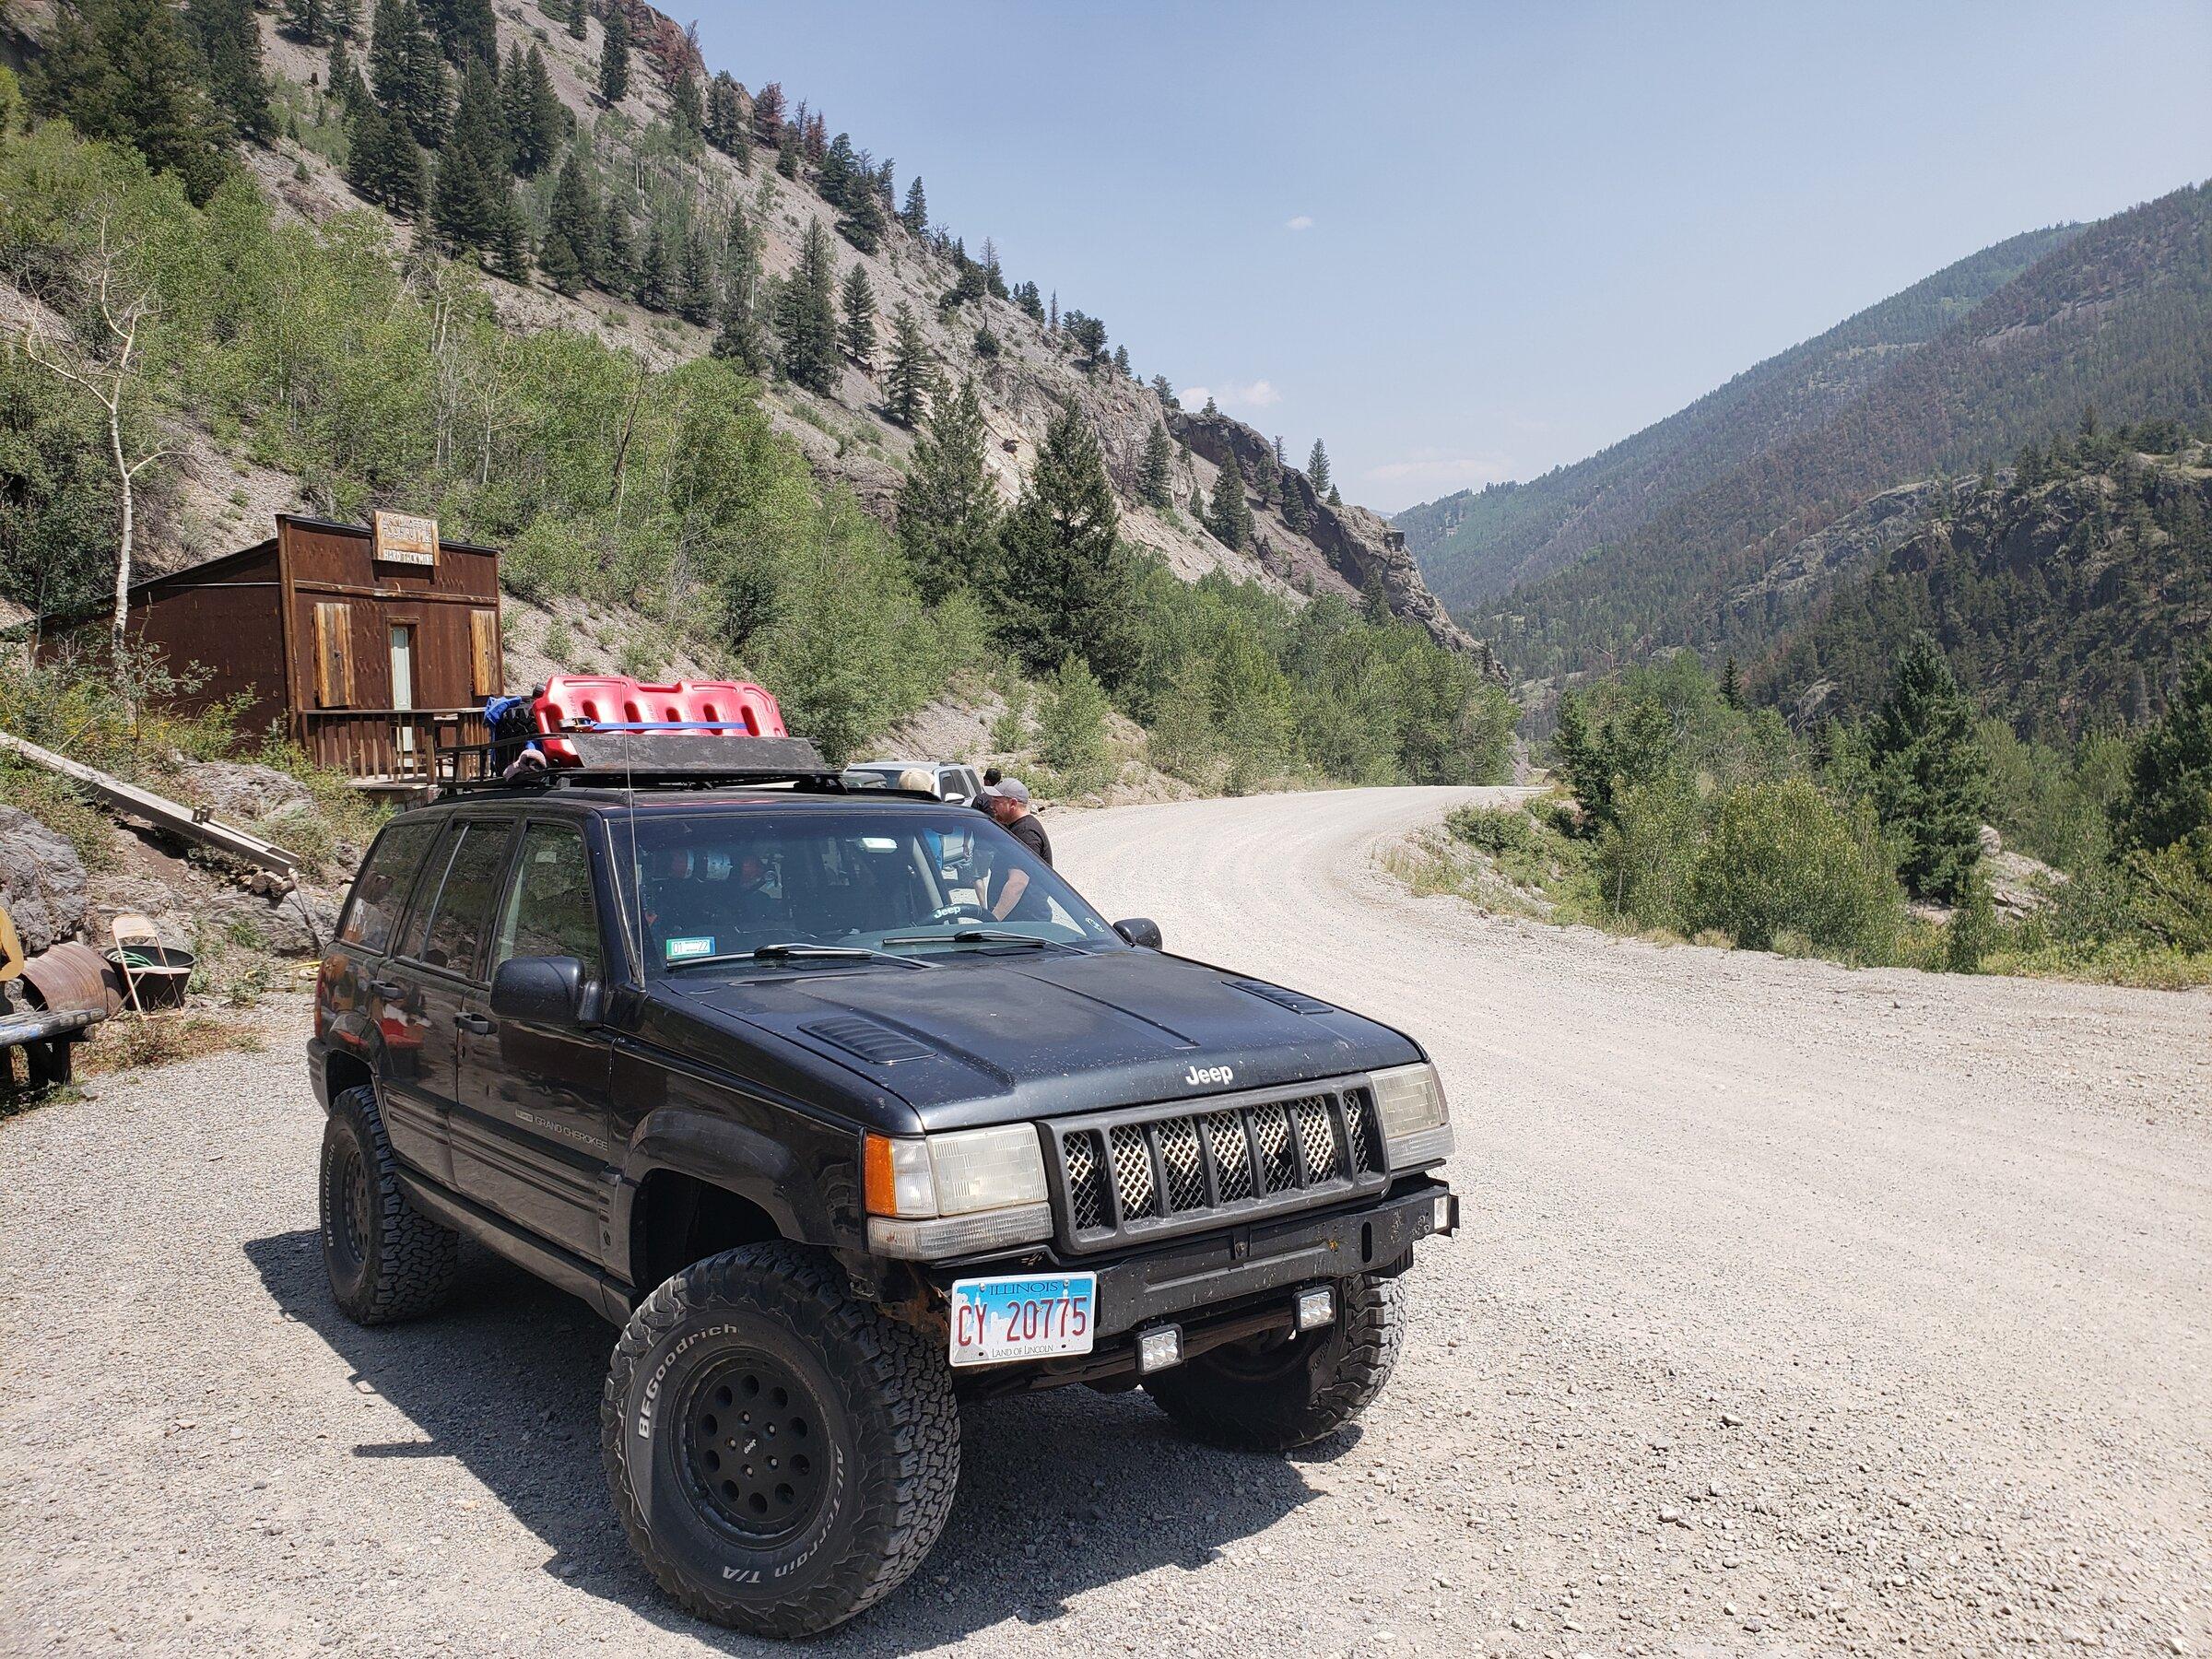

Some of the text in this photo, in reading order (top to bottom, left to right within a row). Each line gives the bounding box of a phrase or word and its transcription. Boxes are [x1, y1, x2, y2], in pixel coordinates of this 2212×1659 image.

[934, 906, 961, 919] Jeep
[1185, 1065, 1234, 1086] Jeep
[535, 1116, 608, 1151] GRAND CHEROKEE
[990, 1282, 1059, 1296] ILLINOIS
[958, 1297, 1088, 1347] CY 20775
[992, 1345, 1054, 1358] LAND OF LINCOLN
[638, 1324, 738, 1440] BFGoodrich
[722, 1565, 762, 1584] T/A
